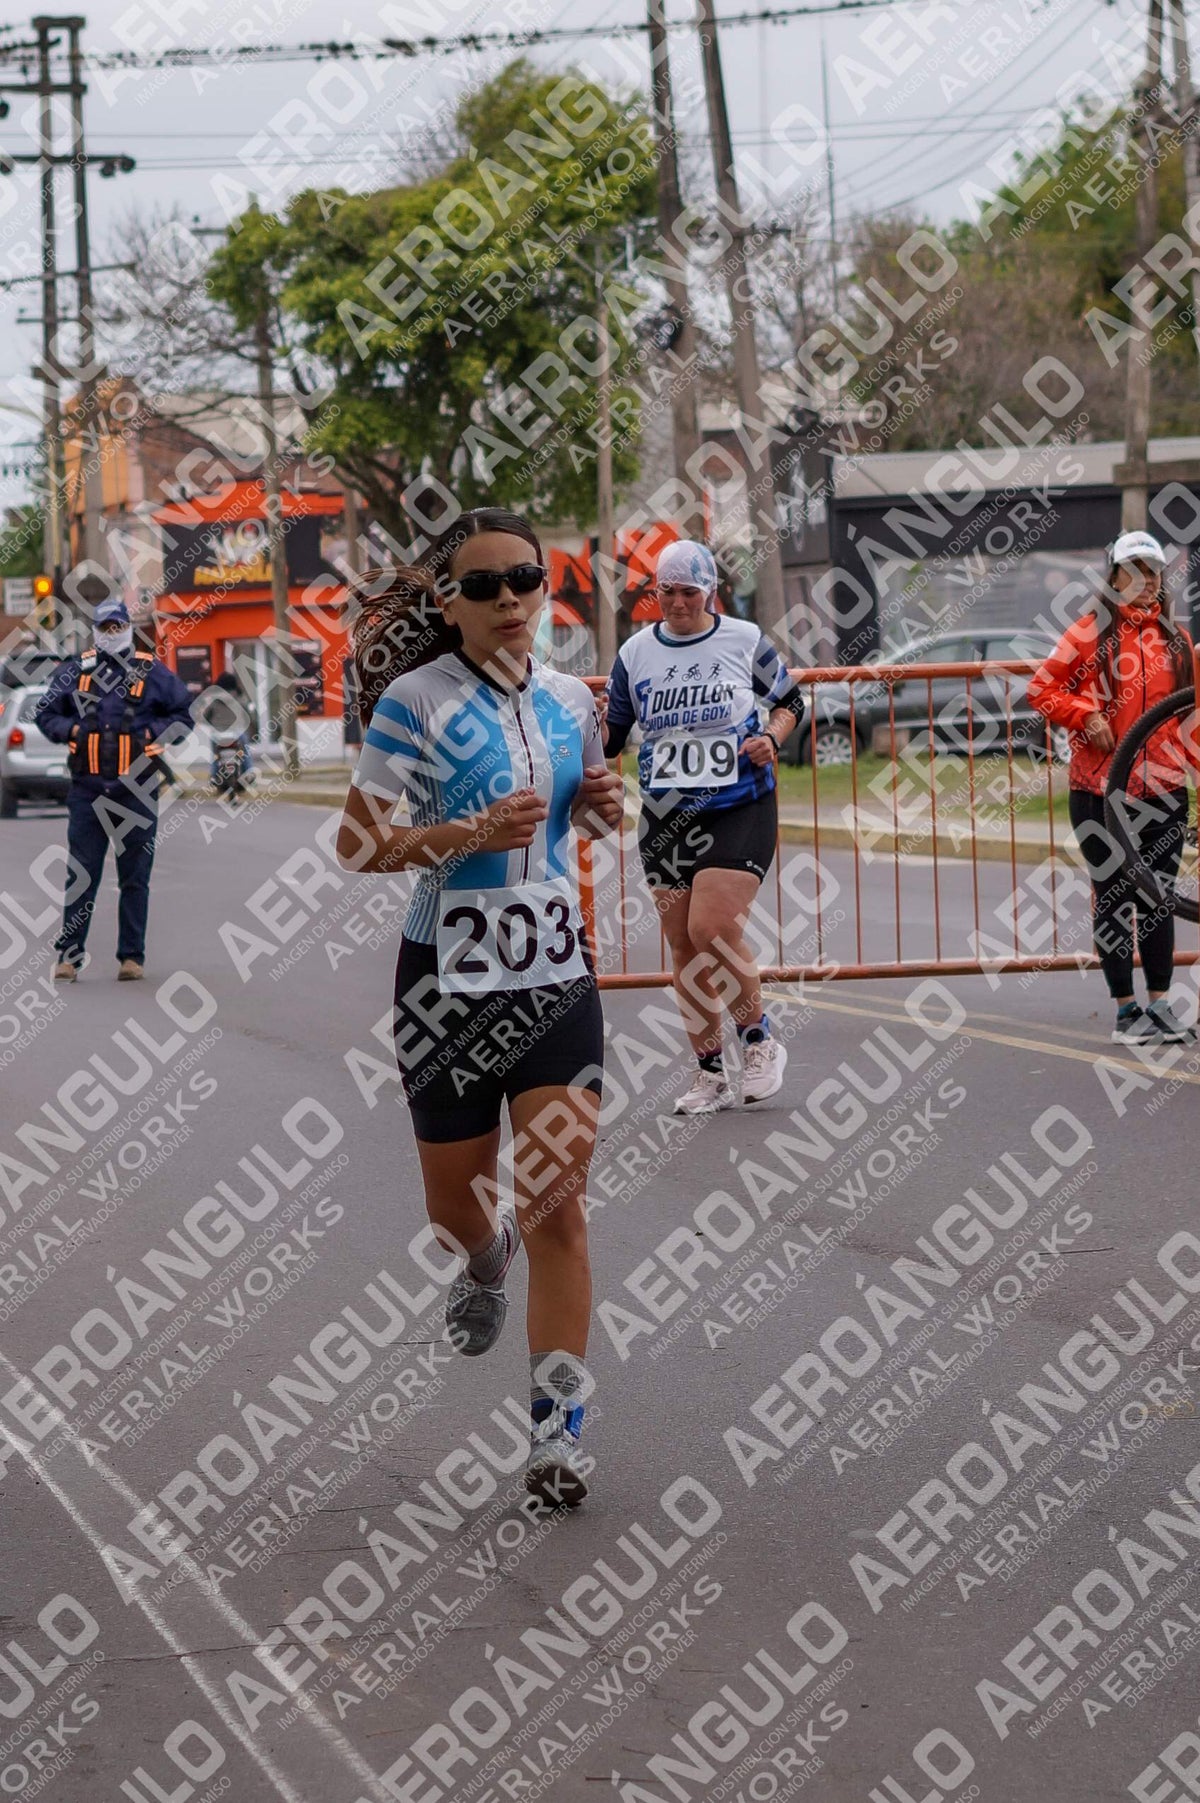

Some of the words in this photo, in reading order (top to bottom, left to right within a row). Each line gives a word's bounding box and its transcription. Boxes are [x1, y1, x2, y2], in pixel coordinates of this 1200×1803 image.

[652, 681, 737, 715] DUATLÓN
[682, 711, 697, 725] DE
[702, 704, 732, 722] GOYA
[653, 738, 735, 780] 209
[442, 895, 576, 976] 203
